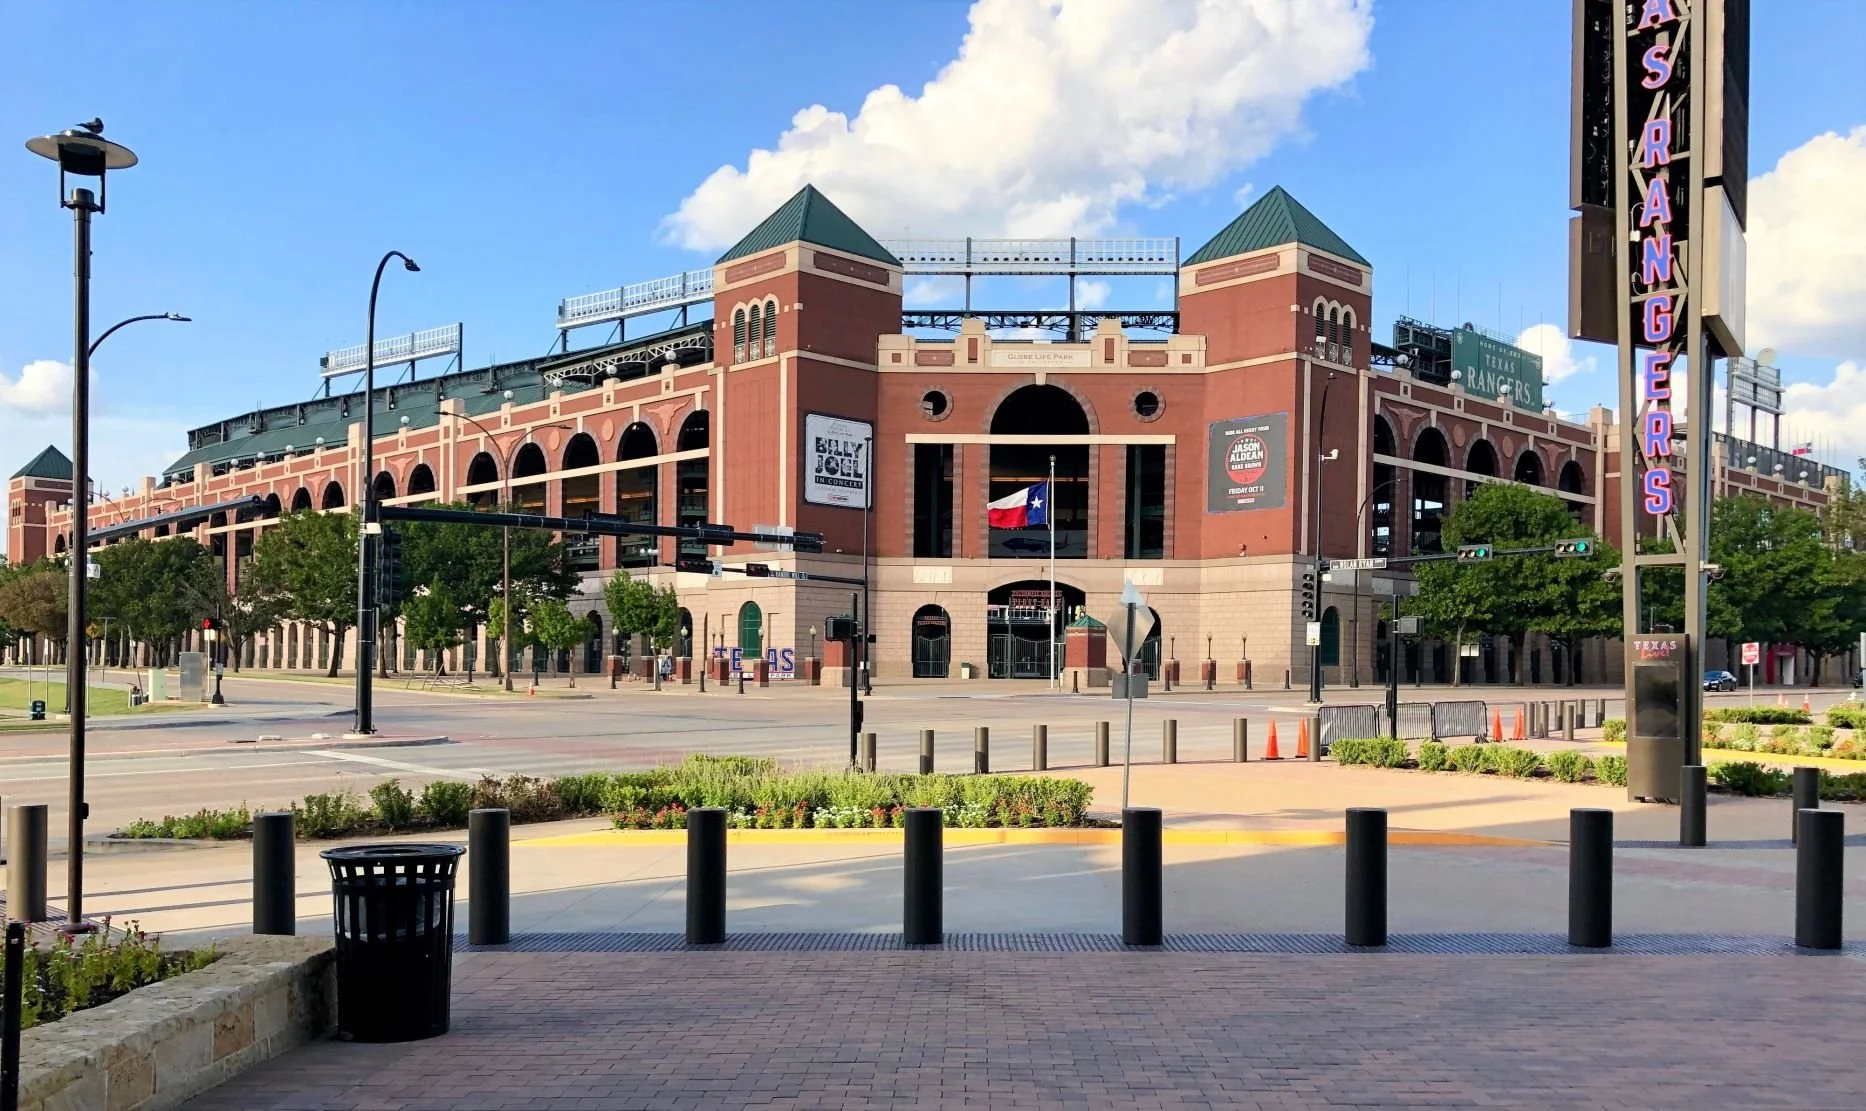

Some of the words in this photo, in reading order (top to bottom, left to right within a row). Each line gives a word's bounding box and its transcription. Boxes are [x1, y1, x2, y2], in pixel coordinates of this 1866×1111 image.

[1639, 118, 1676, 514] RANGERS
[1480, 341, 1496, 351] HOME
[1485, 354, 1515, 373] TEXAS
[815, 436, 864, 459] BILLY
[1232, 442, 1261, 454] JASON
[1230, 450, 1264, 463] ALDEAN
[815, 455, 863, 479] JOEL
[828, 478, 863, 488] CONCERT
[1228, 486, 1248, 495] FRIDAY
[1248, 485, 1259, 493] OCT
[1340, 560, 1357, 569] NOLAN
[1359, 559, 1373, 568] RYAN
[1634, 640, 1677, 650] TEXAS
